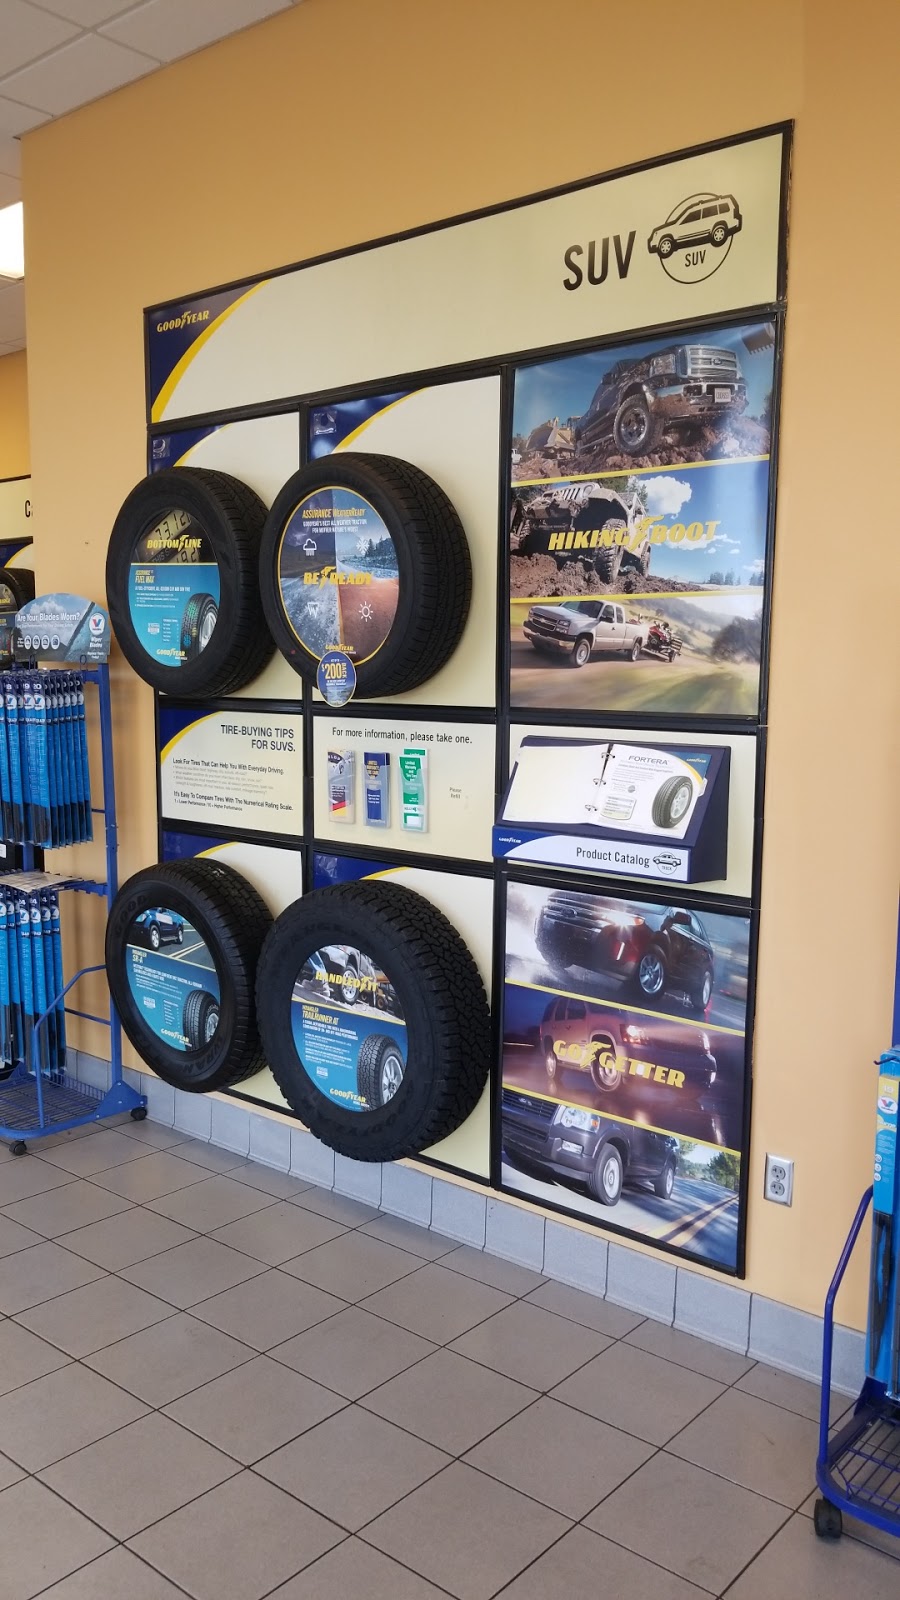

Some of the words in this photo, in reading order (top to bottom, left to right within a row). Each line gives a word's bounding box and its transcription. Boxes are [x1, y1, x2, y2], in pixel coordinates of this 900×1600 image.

[563, 230, 637, 291] SUV
[684, 250, 706, 268] SUV
[156, 310, 210, 333] GOODYEAR
[302, 509, 332, 519] ASSURANCE
[548, 527, 630, 550] HIKING
[650, 520, 721, 544] BOOT
[147, 539, 179, 549] BOTTOM
[185, 539, 202, 548] LINE
[303, 572, 319, 585] BE
[330, 571, 373, 585] READY
[17, 613, 26, 622] Are
[27, 613, 39, 621] Your
[40, 612, 60, 621] Blades
[61, 612, 80, 621] Worn?
[157, 648, 186, 657] GOODYEAR
[321, 662, 342, 679] $200
[220, 724, 272, 738] TIRE-BUYING
[274, 728, 294, 739] TIPS
[332, 727, 343, 736] For
[345, 730, 362, 738] more
[364, 728, 408, 742] information,
[410, 732, 434, 742] please
[436, 733, 453, 743] take
[455, 735, 473, 744] one.
[251, 739, 268, 750] FOR
[270, 741, 296, 752] SUVS.
[628, 755, 668, 766] FORTERA
[248, 765, 267, 774] Everyday
[268, 767, 284, 775] Driving.
[196, 793, 213, 801] Compare
[243, 799, 264, 807] Numerical
[265, 801, 279, 810] Rating
[576, 847, 612, 861] Product
[614, 853, 650, 868] Catalog
[315, 970, 362, 989] HANDLED
[368, 981, 378, 991] IT
[160, 1028, 189, 1043] GOODYEAR
[553, 1040, 584, 1060] GO
[599, 1051, 686, 1088] GETTER
[329, 1088, 366, 1103] GOODYEAR
